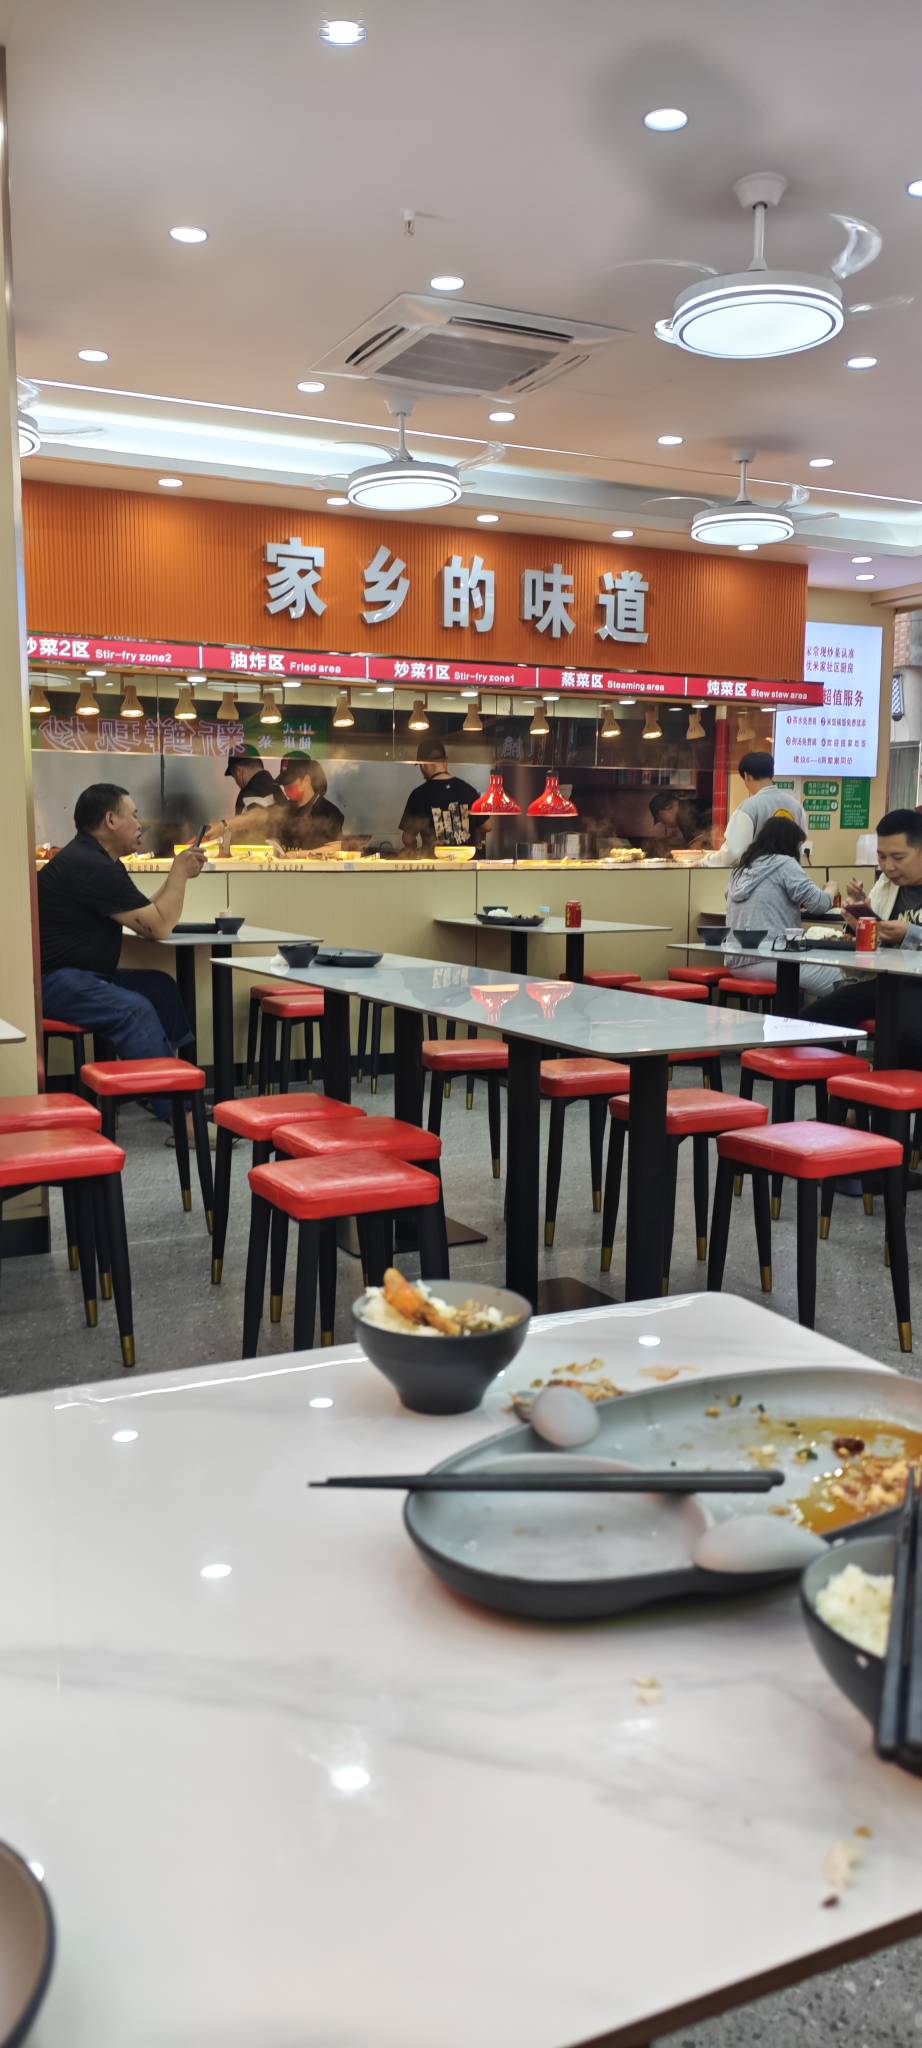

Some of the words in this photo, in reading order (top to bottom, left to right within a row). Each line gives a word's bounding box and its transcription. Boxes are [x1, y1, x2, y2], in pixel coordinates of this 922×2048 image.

[264, 536, 649, 643] 家乡的味道
[95, 648, 137, 662] Stir-fry
[139, 653, 172, 663] zone2
[230, 651, 285, 671] 油炸区
[290, 661, 317, 673] Fried
[318, 664, 341, 673] area
[394, 661, 450, 680] 炒菜1区
[454, 671, 487, 683] Stir-fry
[489, 674, 515, 683] zone1
[561, 672, 603, 688] 蒸菜区
[607, 680, 645, 691] Steaming
[646, 683, 664, 691] area
[707, 680, 747, 697] 炖菜区
[790, 692, 808, 700] area
